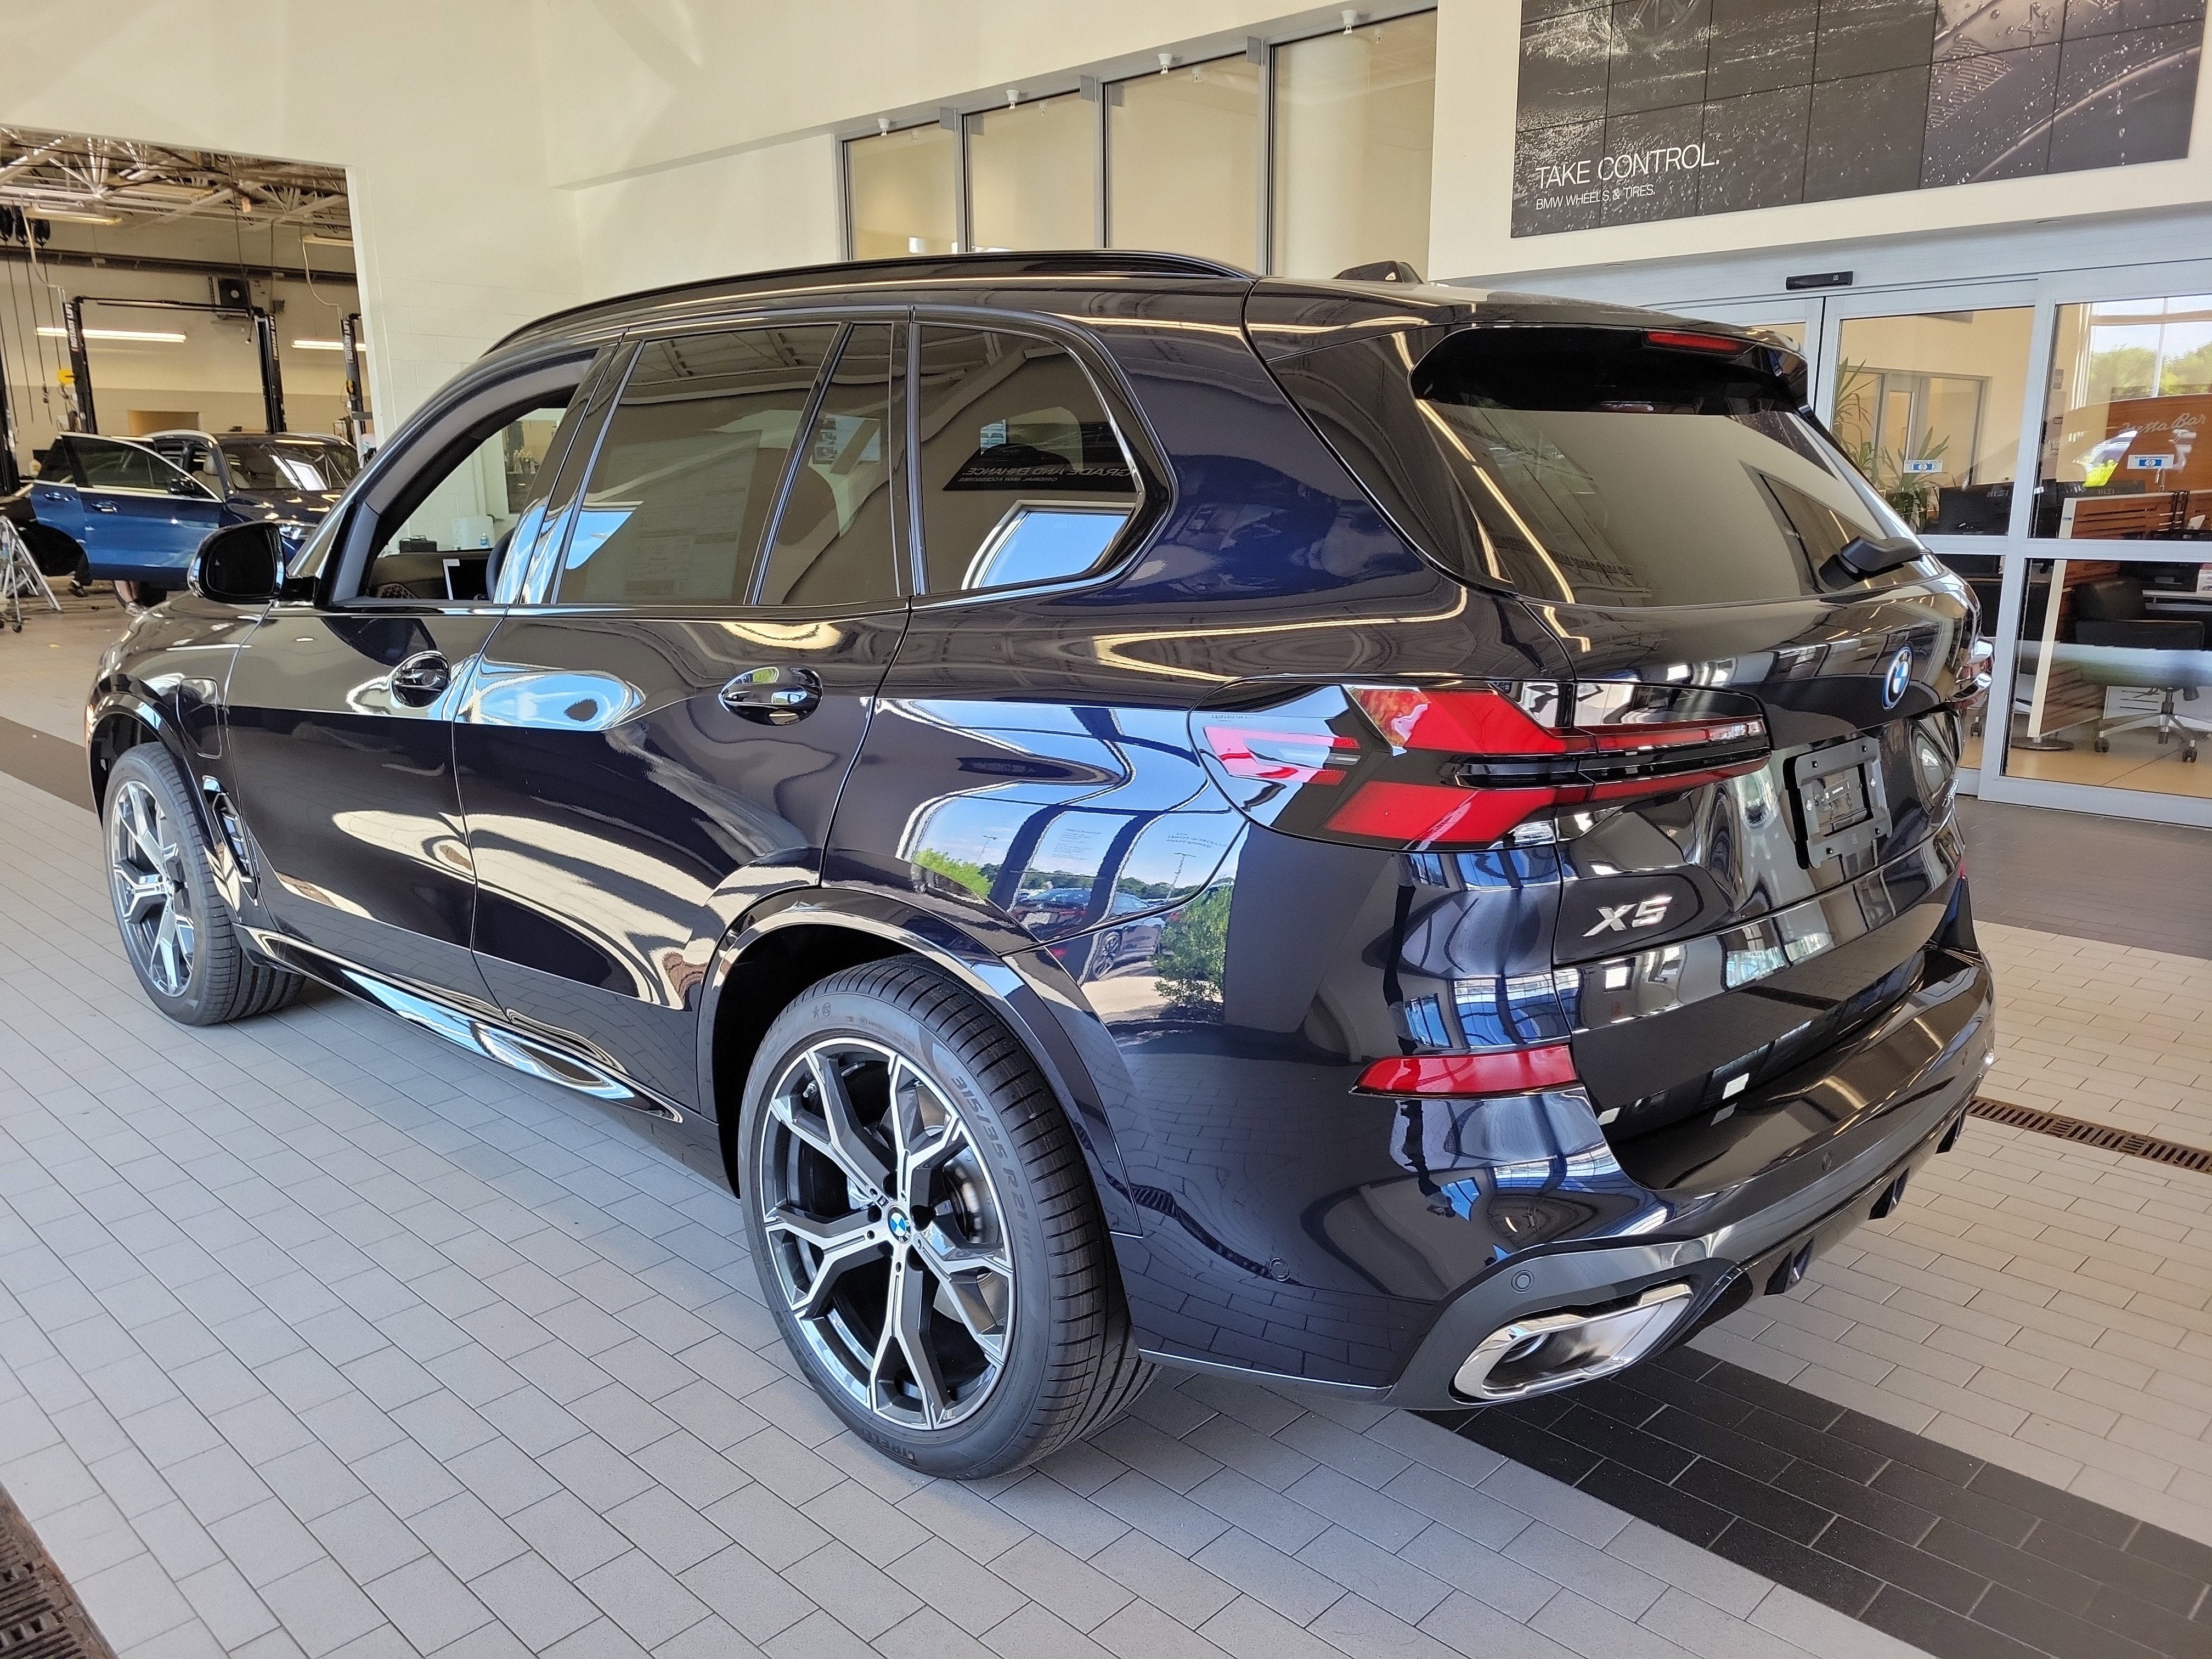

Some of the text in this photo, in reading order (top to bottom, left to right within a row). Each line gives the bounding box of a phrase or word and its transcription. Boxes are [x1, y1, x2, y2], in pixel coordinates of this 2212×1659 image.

[1536, 142, 1720, 190] TAKE CONTROL.
[1536, 184, 1656, 211] BMW WHEELS & TIRES.
[2170, 412, 2207, 430] Bar
[1581, 896, 1673, 937] X5
[951, 1076, 1008, 1159] 315/35
[1002, 1167, 1018, 1188] R
